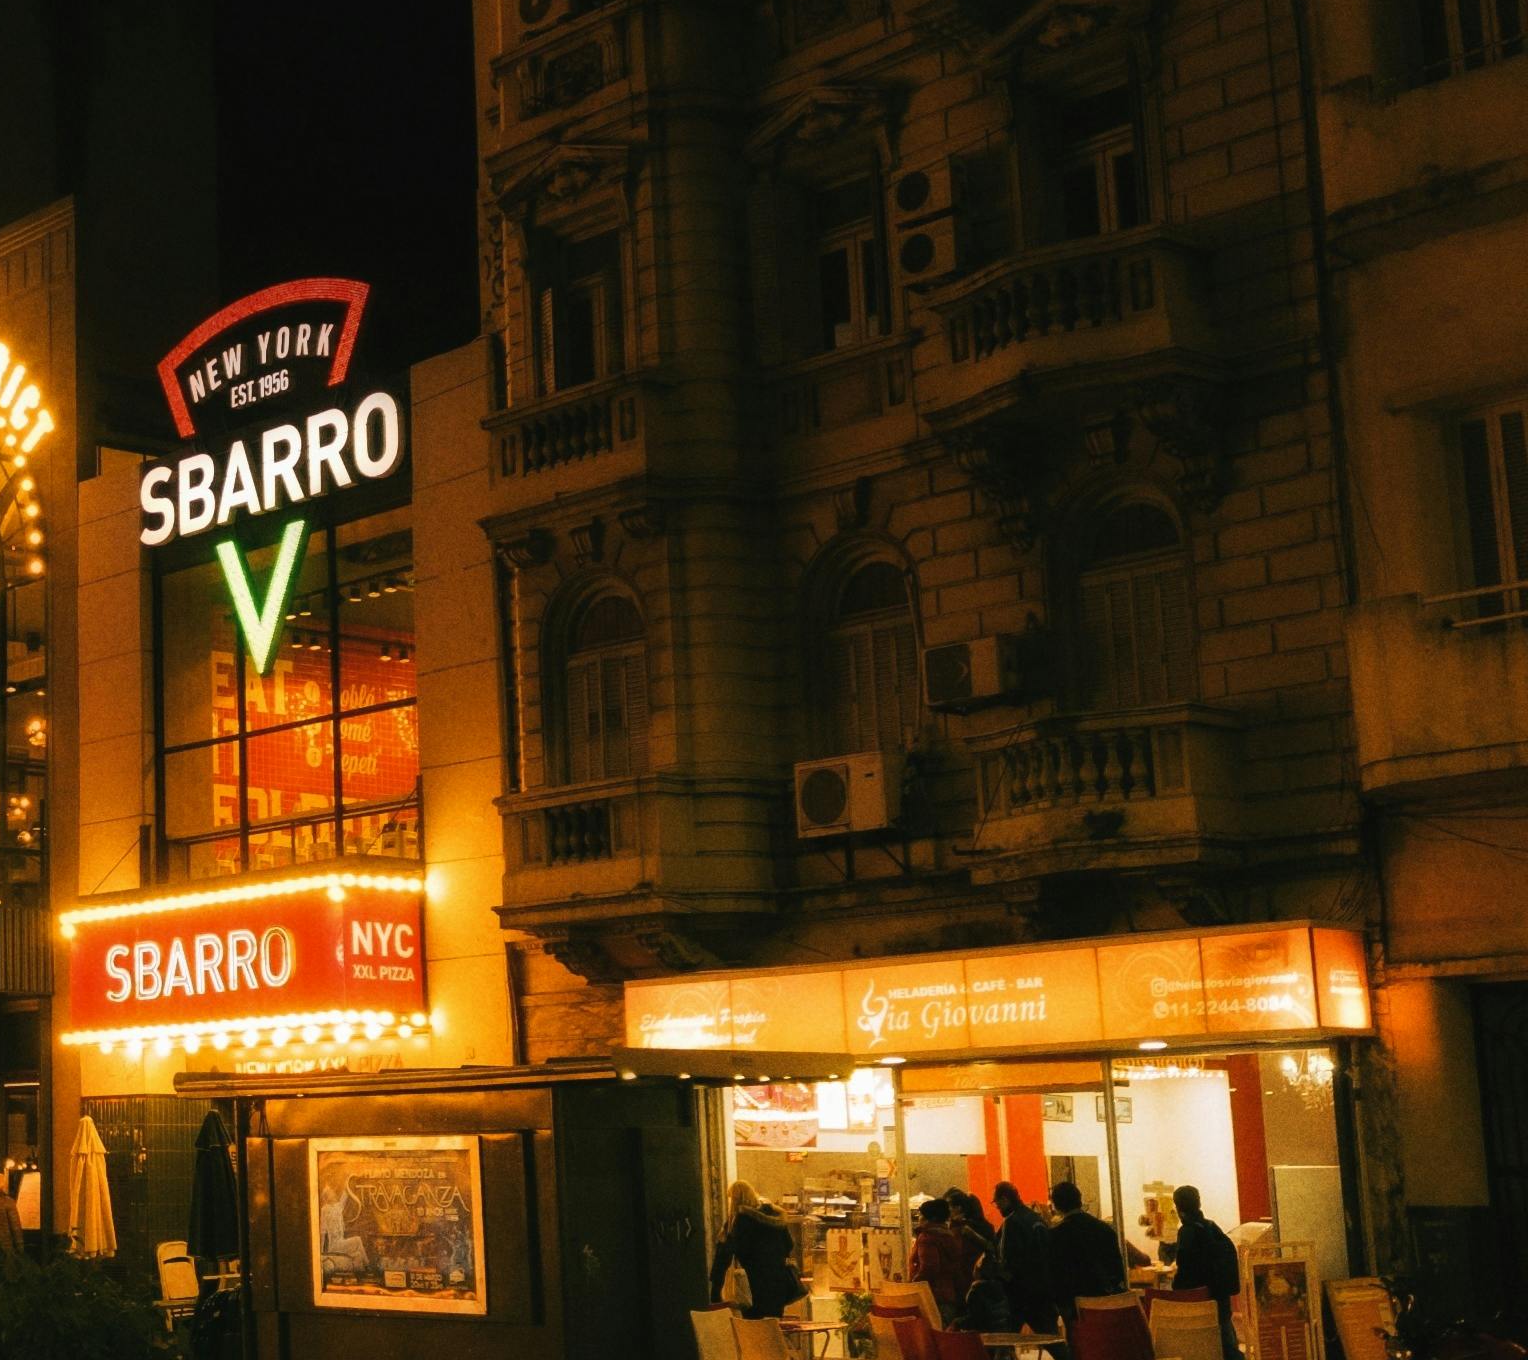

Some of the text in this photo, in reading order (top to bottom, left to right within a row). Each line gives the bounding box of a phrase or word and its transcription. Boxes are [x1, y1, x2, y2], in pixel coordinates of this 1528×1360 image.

[188, 323, 335, 404] NEW YORK
[230, 369, 290, 409] EST. 1956
[140, 392, 399, 546] SBARRO
[211, 651, 293, 716] EAT
[106, 920, 414, 1003] SBARRO NYC
[352, 963, 415, 982] XXL PIZZA
[921, 994, 1047, 1038] Giovanni
[346, 1173, 470, 1223] STRAVAGANZA
